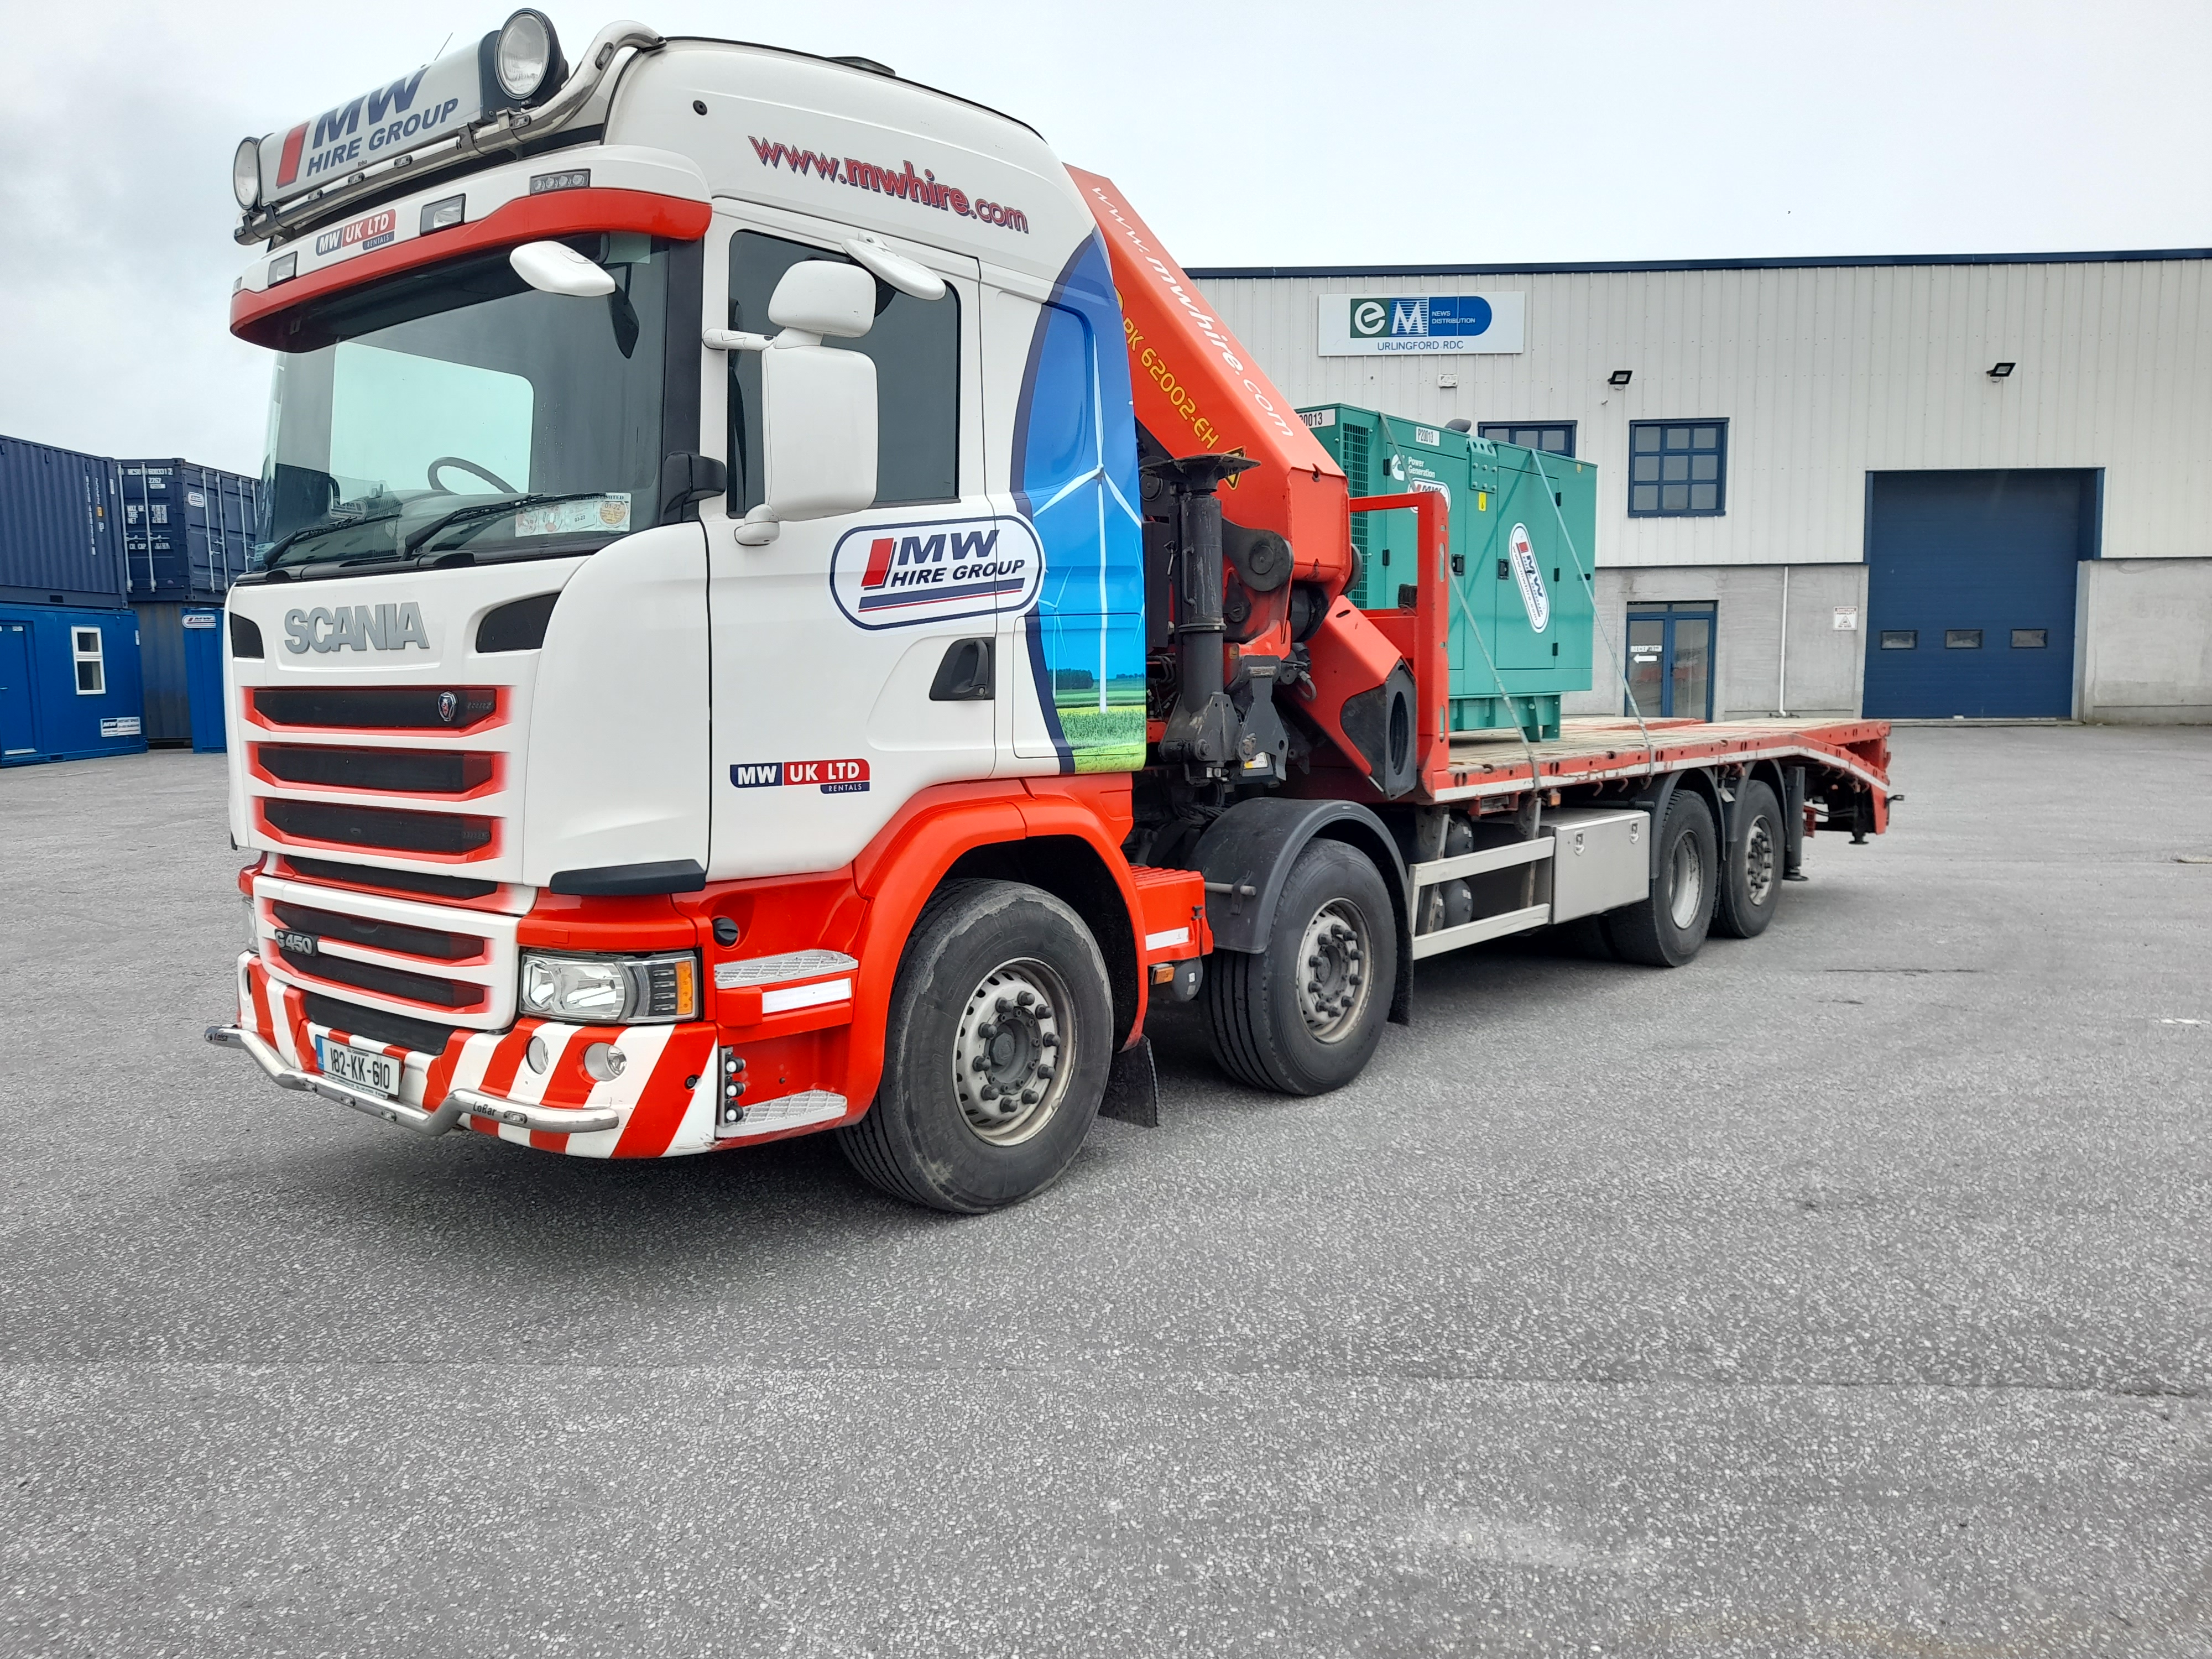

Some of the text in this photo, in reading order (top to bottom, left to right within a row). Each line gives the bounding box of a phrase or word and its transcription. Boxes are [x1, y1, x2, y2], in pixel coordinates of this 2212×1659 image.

[312, 66, 431, 149] MW
[306, 98, 458, 177] HIRE GROUP
[748, 135, 1029, 234] www.mwhire.com
[319, 213, 389, 253] MW UK LTD
[367, 234, 389, 248] RENTALS
[1378, 341, 1464, 351] URLINGFORD RDC
[1123, 317, 1220, 449] PK 62002-EH
[1418, 428, 1433, 444] P20013
[1408, 456, 1425, 467] Power
[1408, 465, 1436, 478] Generation
[898, 529, 1000, 566] MW
[891, 560, 1025, 587] HIRE GROUP
[1527, 555, 1543, 598] MW
[284, 601, 430, 654] SCANIA
[738, 762, 860, 785] MW UK LTD
[828, 784, 863, 792] RENTALS
[275, 931, 313, 954] G 450
[330, 1047, 390, 1089] 182-KK-610
[473, 1101, 497, 1116] LoBar
